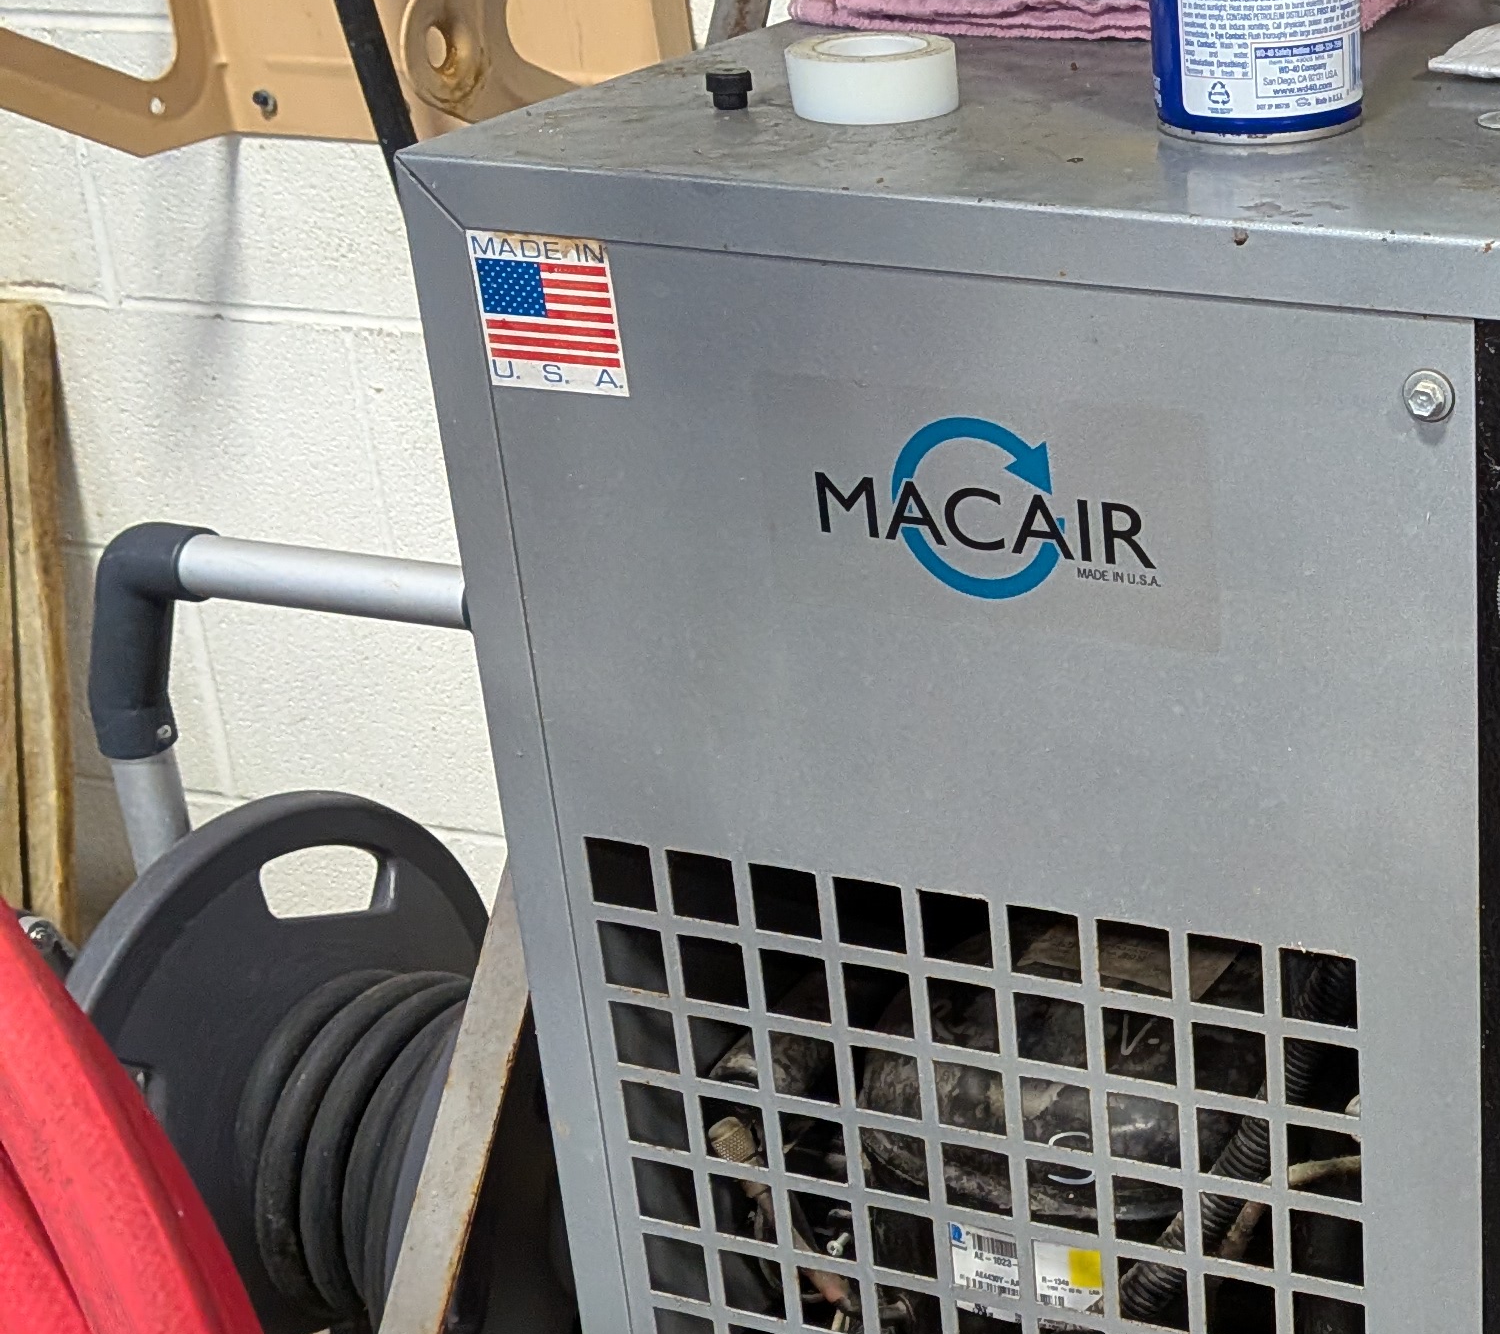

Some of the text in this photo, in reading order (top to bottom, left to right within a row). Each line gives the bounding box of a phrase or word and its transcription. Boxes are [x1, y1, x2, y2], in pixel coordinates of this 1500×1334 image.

[1263, 77, 1276, 86] San
[1277, 77, 1296, 85] Diego,
[1297, 75, 1307, 83] CA
[1279, 63, 1327, 74] WD-40 Company
[470, 235, 605, 264] MADE IN
[492, 359, 624, 389] U. S. A.
[814, 471, 1157, 569] MACAIR
[1077, 567, 1162, 587] MADE IN U.S.A.
